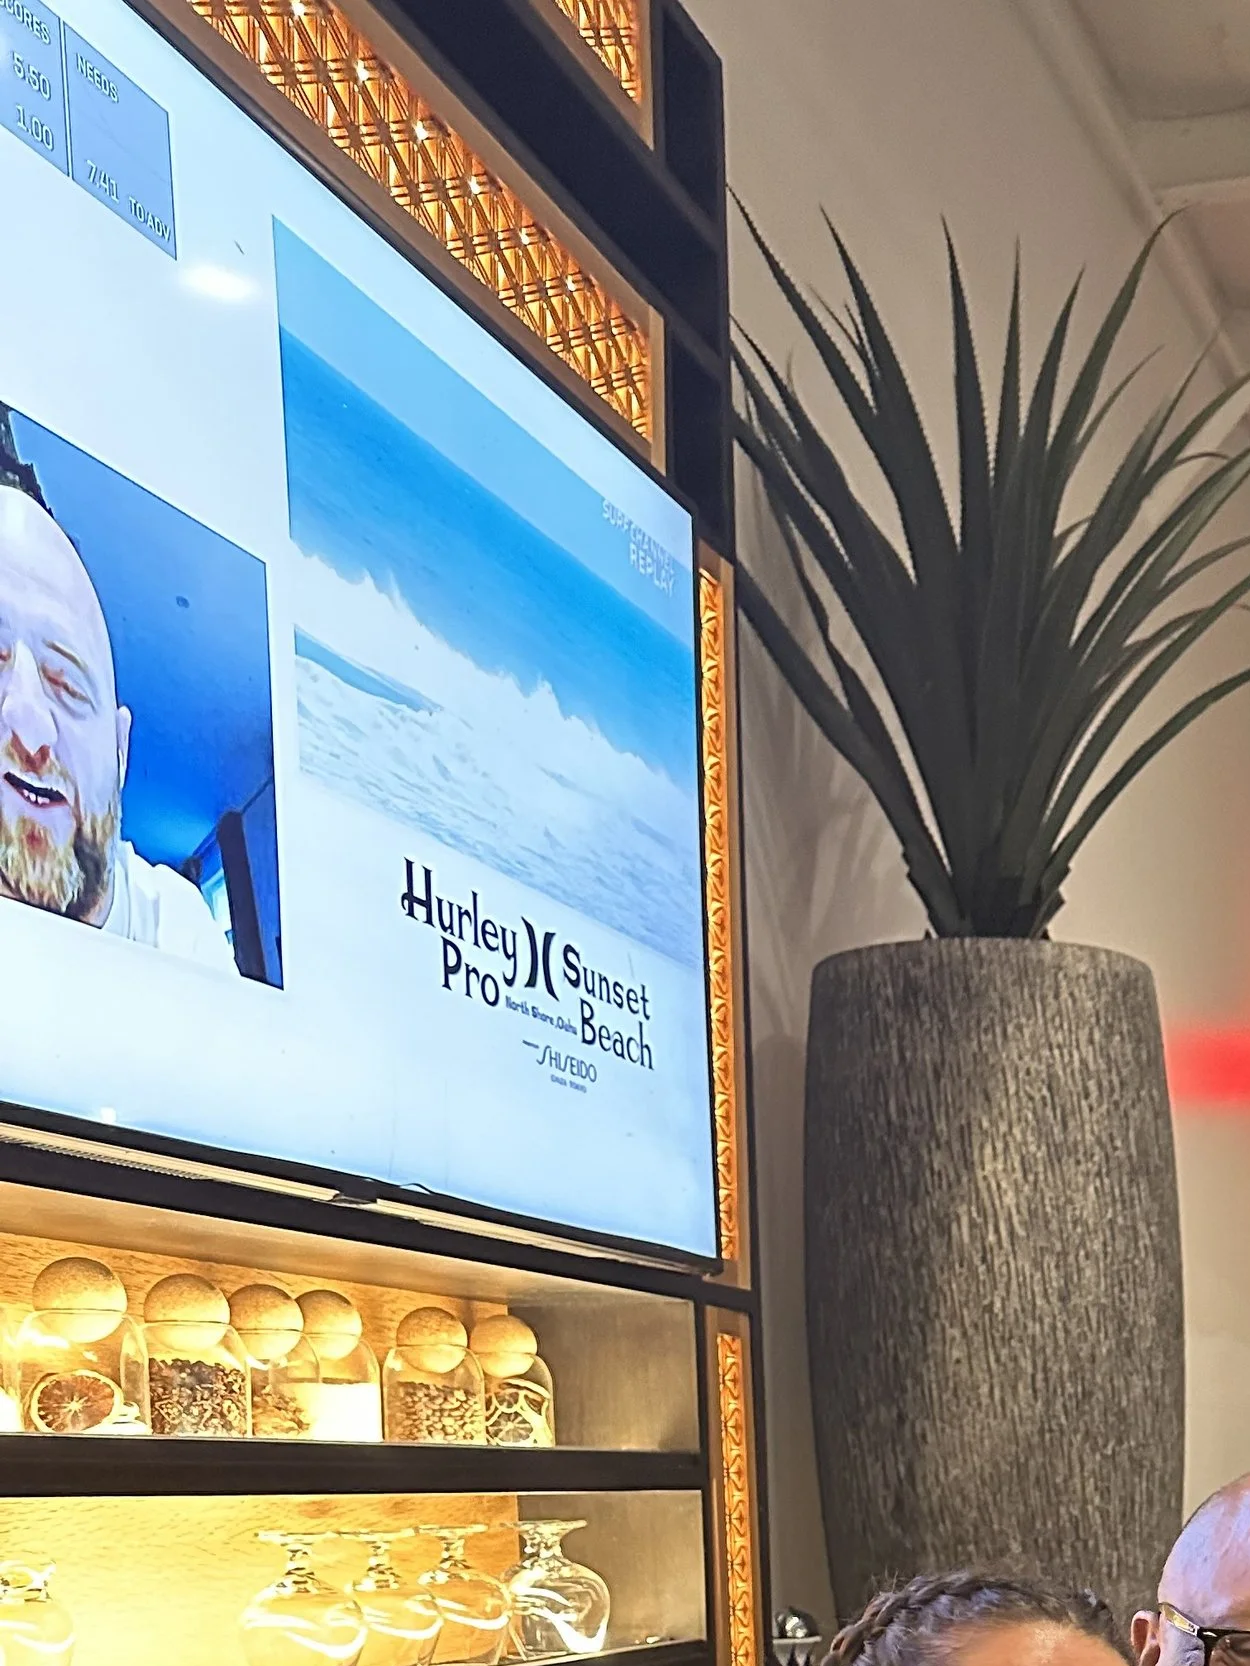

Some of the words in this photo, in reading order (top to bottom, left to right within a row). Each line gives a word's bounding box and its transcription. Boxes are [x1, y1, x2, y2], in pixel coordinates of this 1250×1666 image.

[0, 0, 51, 45] CORES
[12, 51, 51, 100] 5.50
[76, 53, 119, 103] NEEDS
[15, 104, 54, 151] 1.00
[86, 159, 119, 204] 7.41
[128, 196, 147, 223] TO
[146, 214, 171, 243] ADV
[400, 856, 517, 988] Hurley
[562, 943, 652, 1021] Sunset
[440, 935, 500, 1008] Pro
[579, 997, 655, 1071] Beach
[505, 995, 530, 1016] North
[536, 1045, 597, 1083] SHISEIDO
